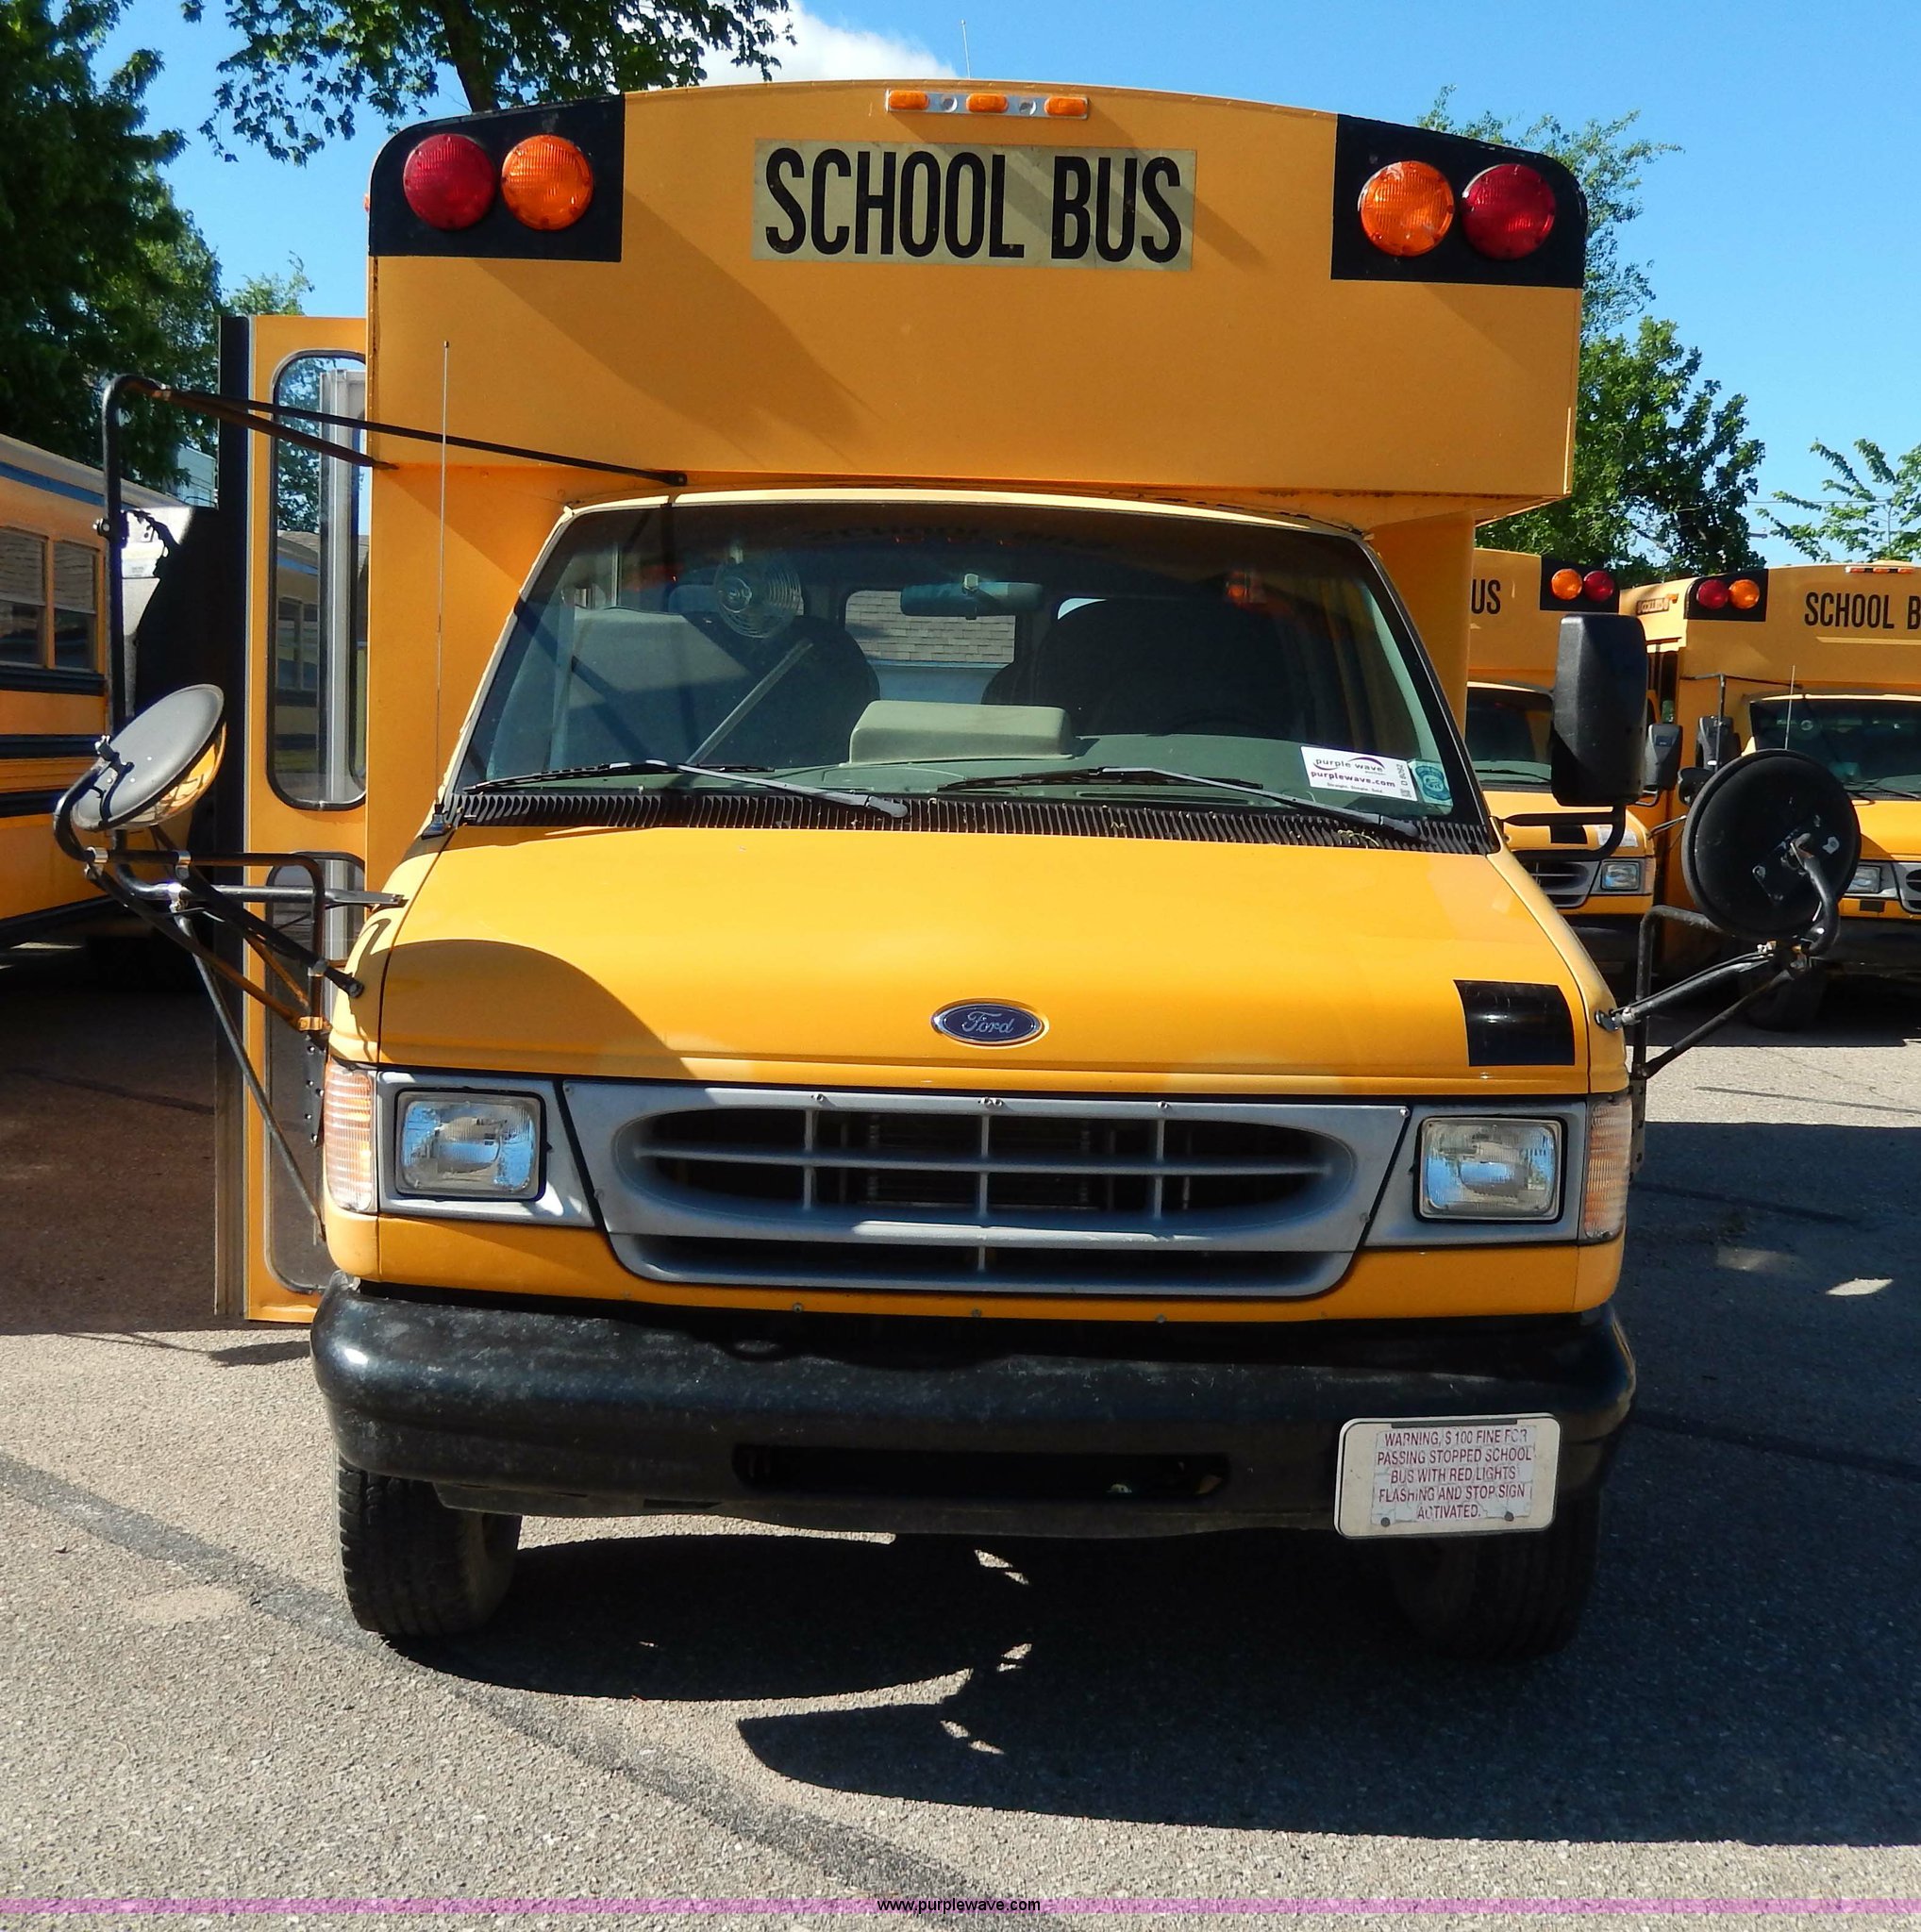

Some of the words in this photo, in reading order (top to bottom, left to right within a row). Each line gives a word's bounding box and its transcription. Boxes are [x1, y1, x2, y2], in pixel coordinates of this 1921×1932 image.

[765, 147, 1025, 258] SCHOOL
[1051, 156, 1181, 263] BUS
[1805, 591, 1895, 629] SCHOOL
[1315, 758, 1351, 769] purple
[1354, 762, 1384, 772] wave
[1311, 770, 1396, 789] purplewave.com
[961, 1010, 1014, 1033] Ford
[1384, 1431, 1442, 1447] WARNING,
[1477, 1429, 1501, 1443] FINE
[1378, 1450, 1426, 1465] PASSING
[1429, 1448, 1482, 1463] STOPPED
[1485, 1447, 1531, 1462] SCHOOL
[1391, 1470, 1414, 1484] BUS
[1417, 1468, 1446, 1483] WITH
[1449, 1467, 1473, 1481] RED
[1476, 1465, 1516, 1480] LIGHTS
[1438, 1486, 1462, 1501] AND
[1465, 1485, 1495, 1500] STOP
[1498, 1483, 1526, 1498] SIGN
